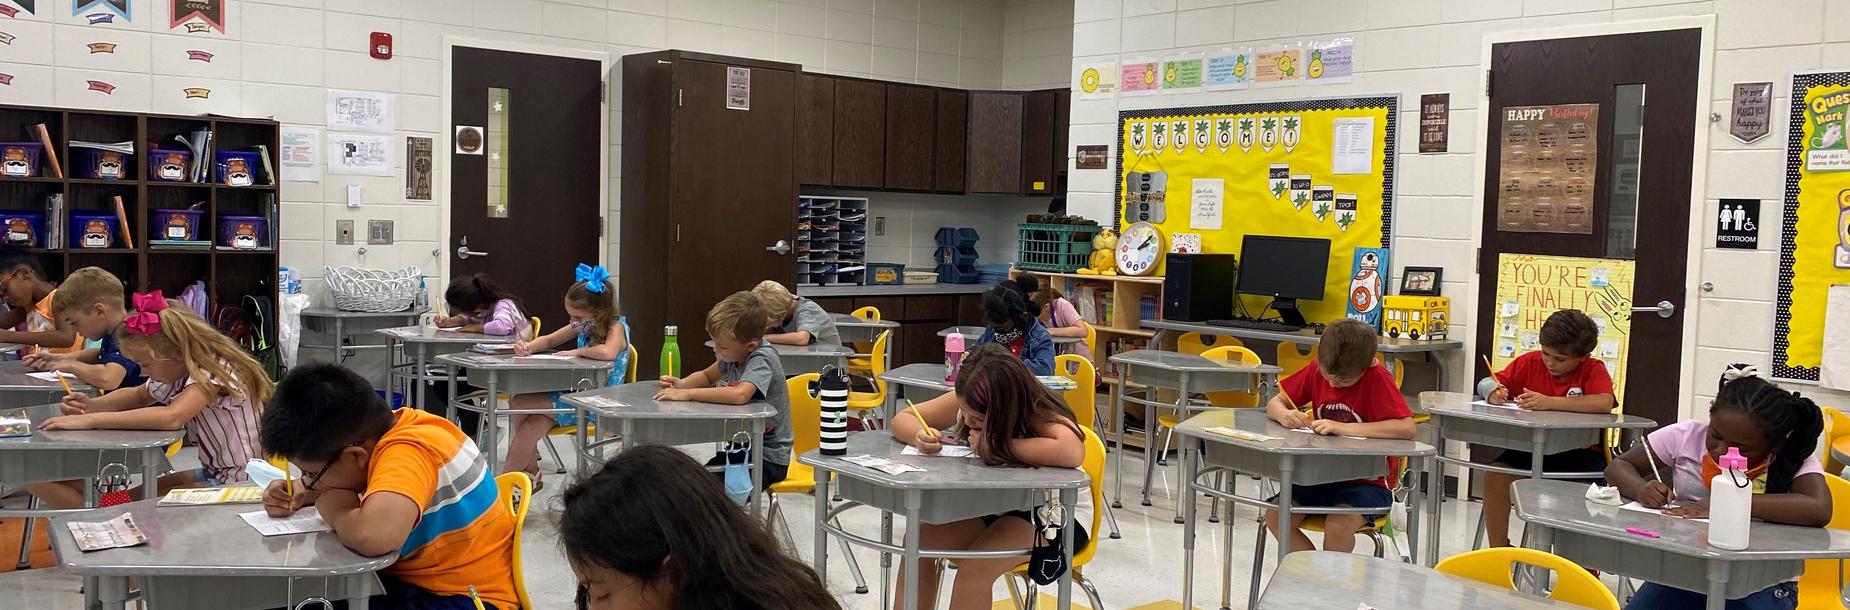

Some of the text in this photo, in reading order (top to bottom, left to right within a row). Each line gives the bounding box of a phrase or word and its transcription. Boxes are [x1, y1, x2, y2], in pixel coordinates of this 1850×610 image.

[1507, 107, 1594, 121] HAPPY Birthday!
[1816, 112, 1843, 125] Mark
[1736, 118, 1763, 130] happy
[1717, 235, 1757, 243] RESTROOM
[1512, 263, 1587, 288] YOU'RE
[1516, 286, 1595, 312] FINALLY
